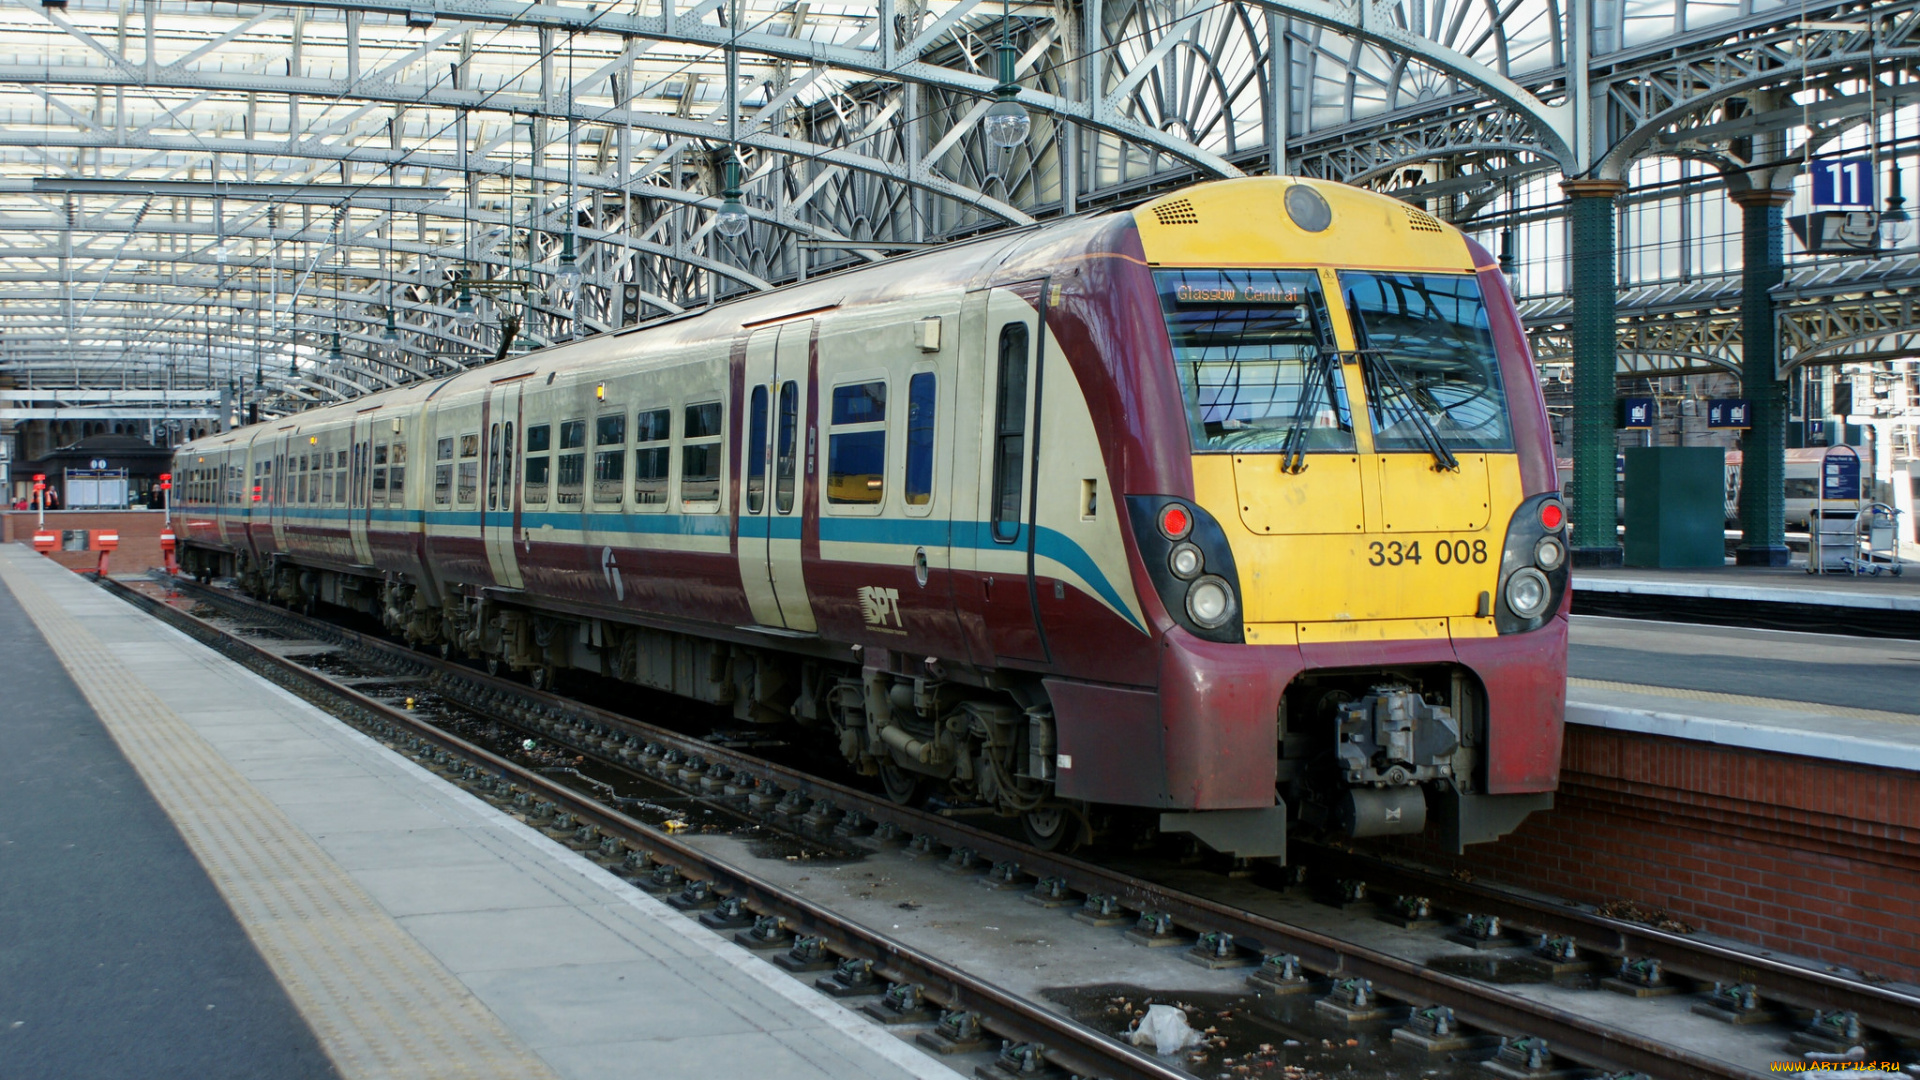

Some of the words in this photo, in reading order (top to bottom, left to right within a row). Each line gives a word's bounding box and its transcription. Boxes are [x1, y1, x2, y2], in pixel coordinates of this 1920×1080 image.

[1826, 162, 1859, 204] 11
[1177, 285, 1236, 301] Glasgow
[1244, 286, 1298, 302] Central
[1368, 541, 1422, 566] 334
[1435, 539, 1488, 565] 008
[857, 585, 903, 628] SPT
